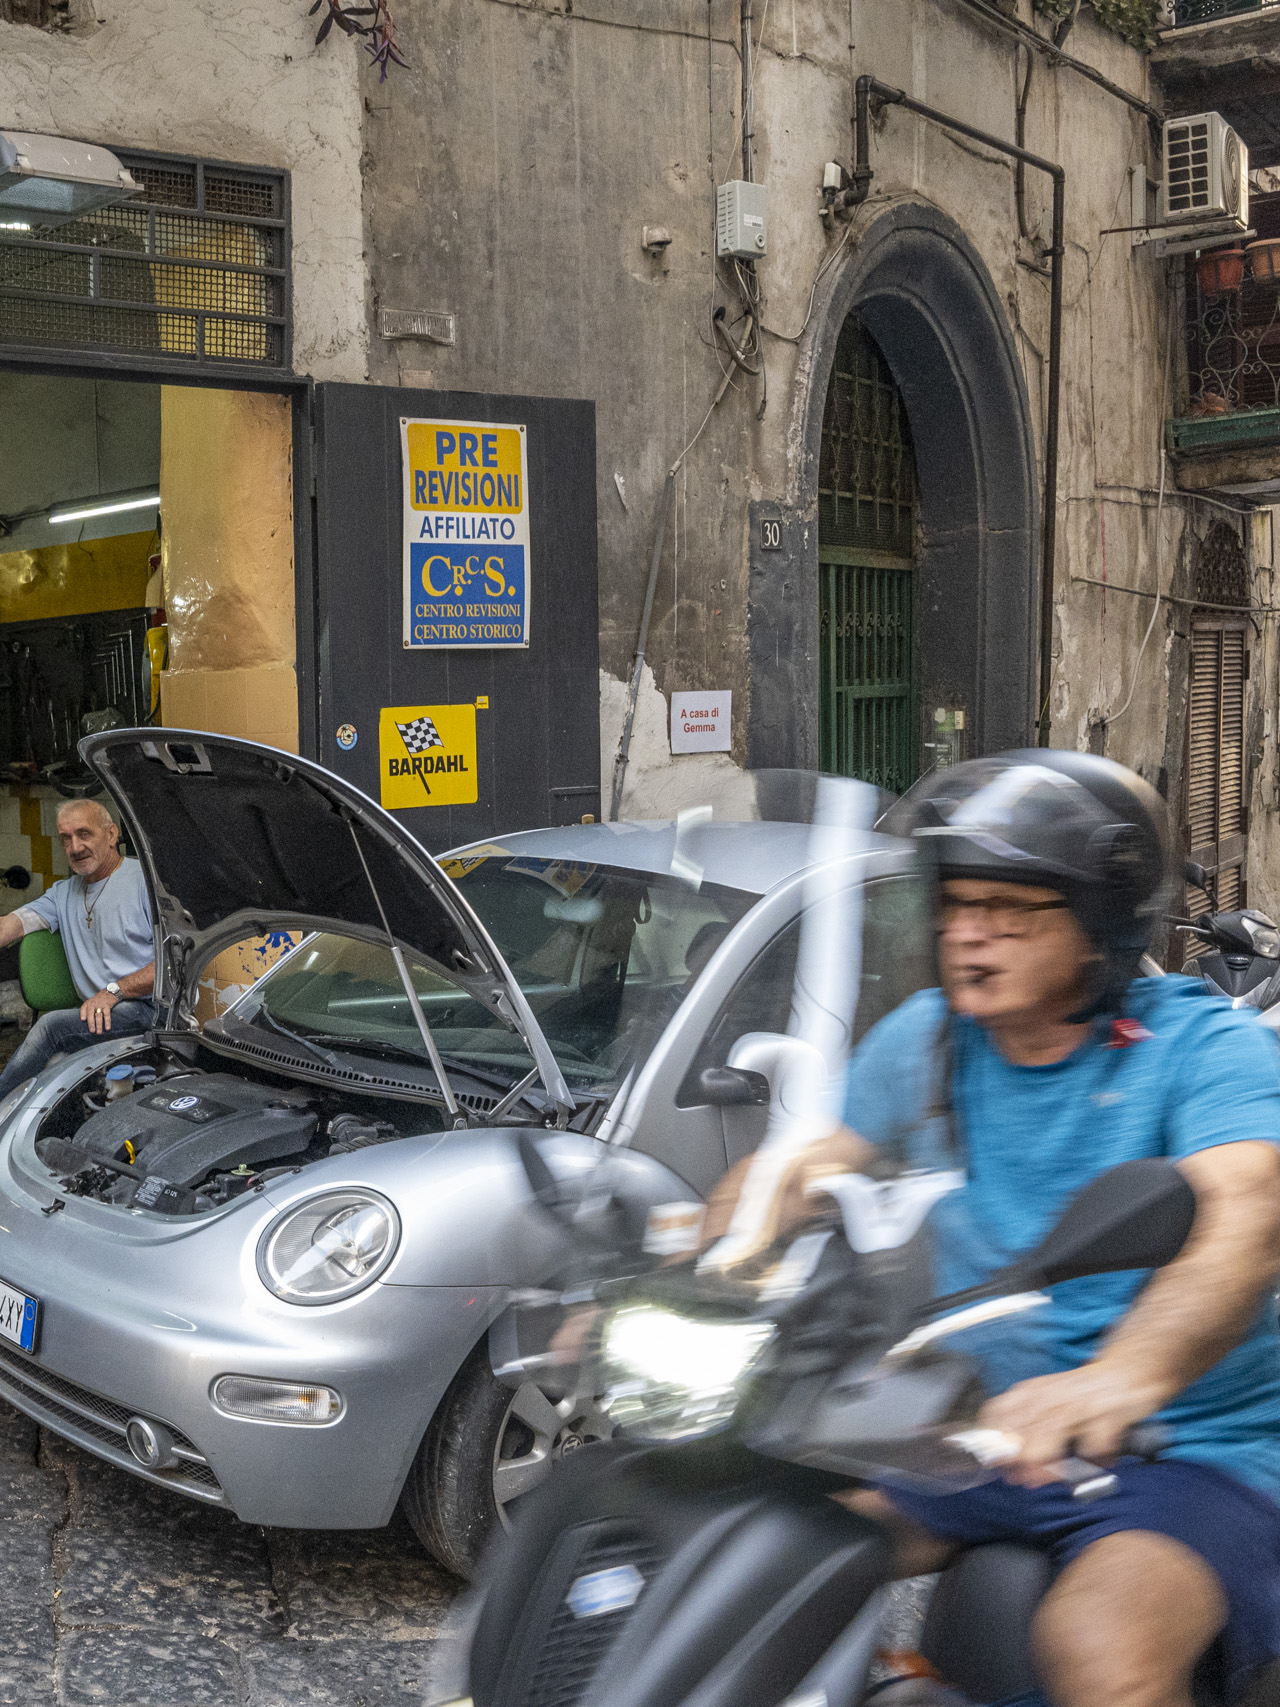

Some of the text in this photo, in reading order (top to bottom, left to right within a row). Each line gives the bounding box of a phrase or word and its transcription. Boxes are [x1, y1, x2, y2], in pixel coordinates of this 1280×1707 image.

[435, 431, 498, 468] PRE
[414, 469, 520, 507] REVISIONI
[419, 515, 516, 540] AFFILIATO
[764, 522, 780, 547] 30
[415, 604, 521, 618] CENTRO REVISIONI
[414, 624, 521, 639] CENTRO STORICO
[680, 708, 719, 719] A casa di
[683, 723, 716, 733] Gemma
[389, 755, 468, 776] BARDAHL
